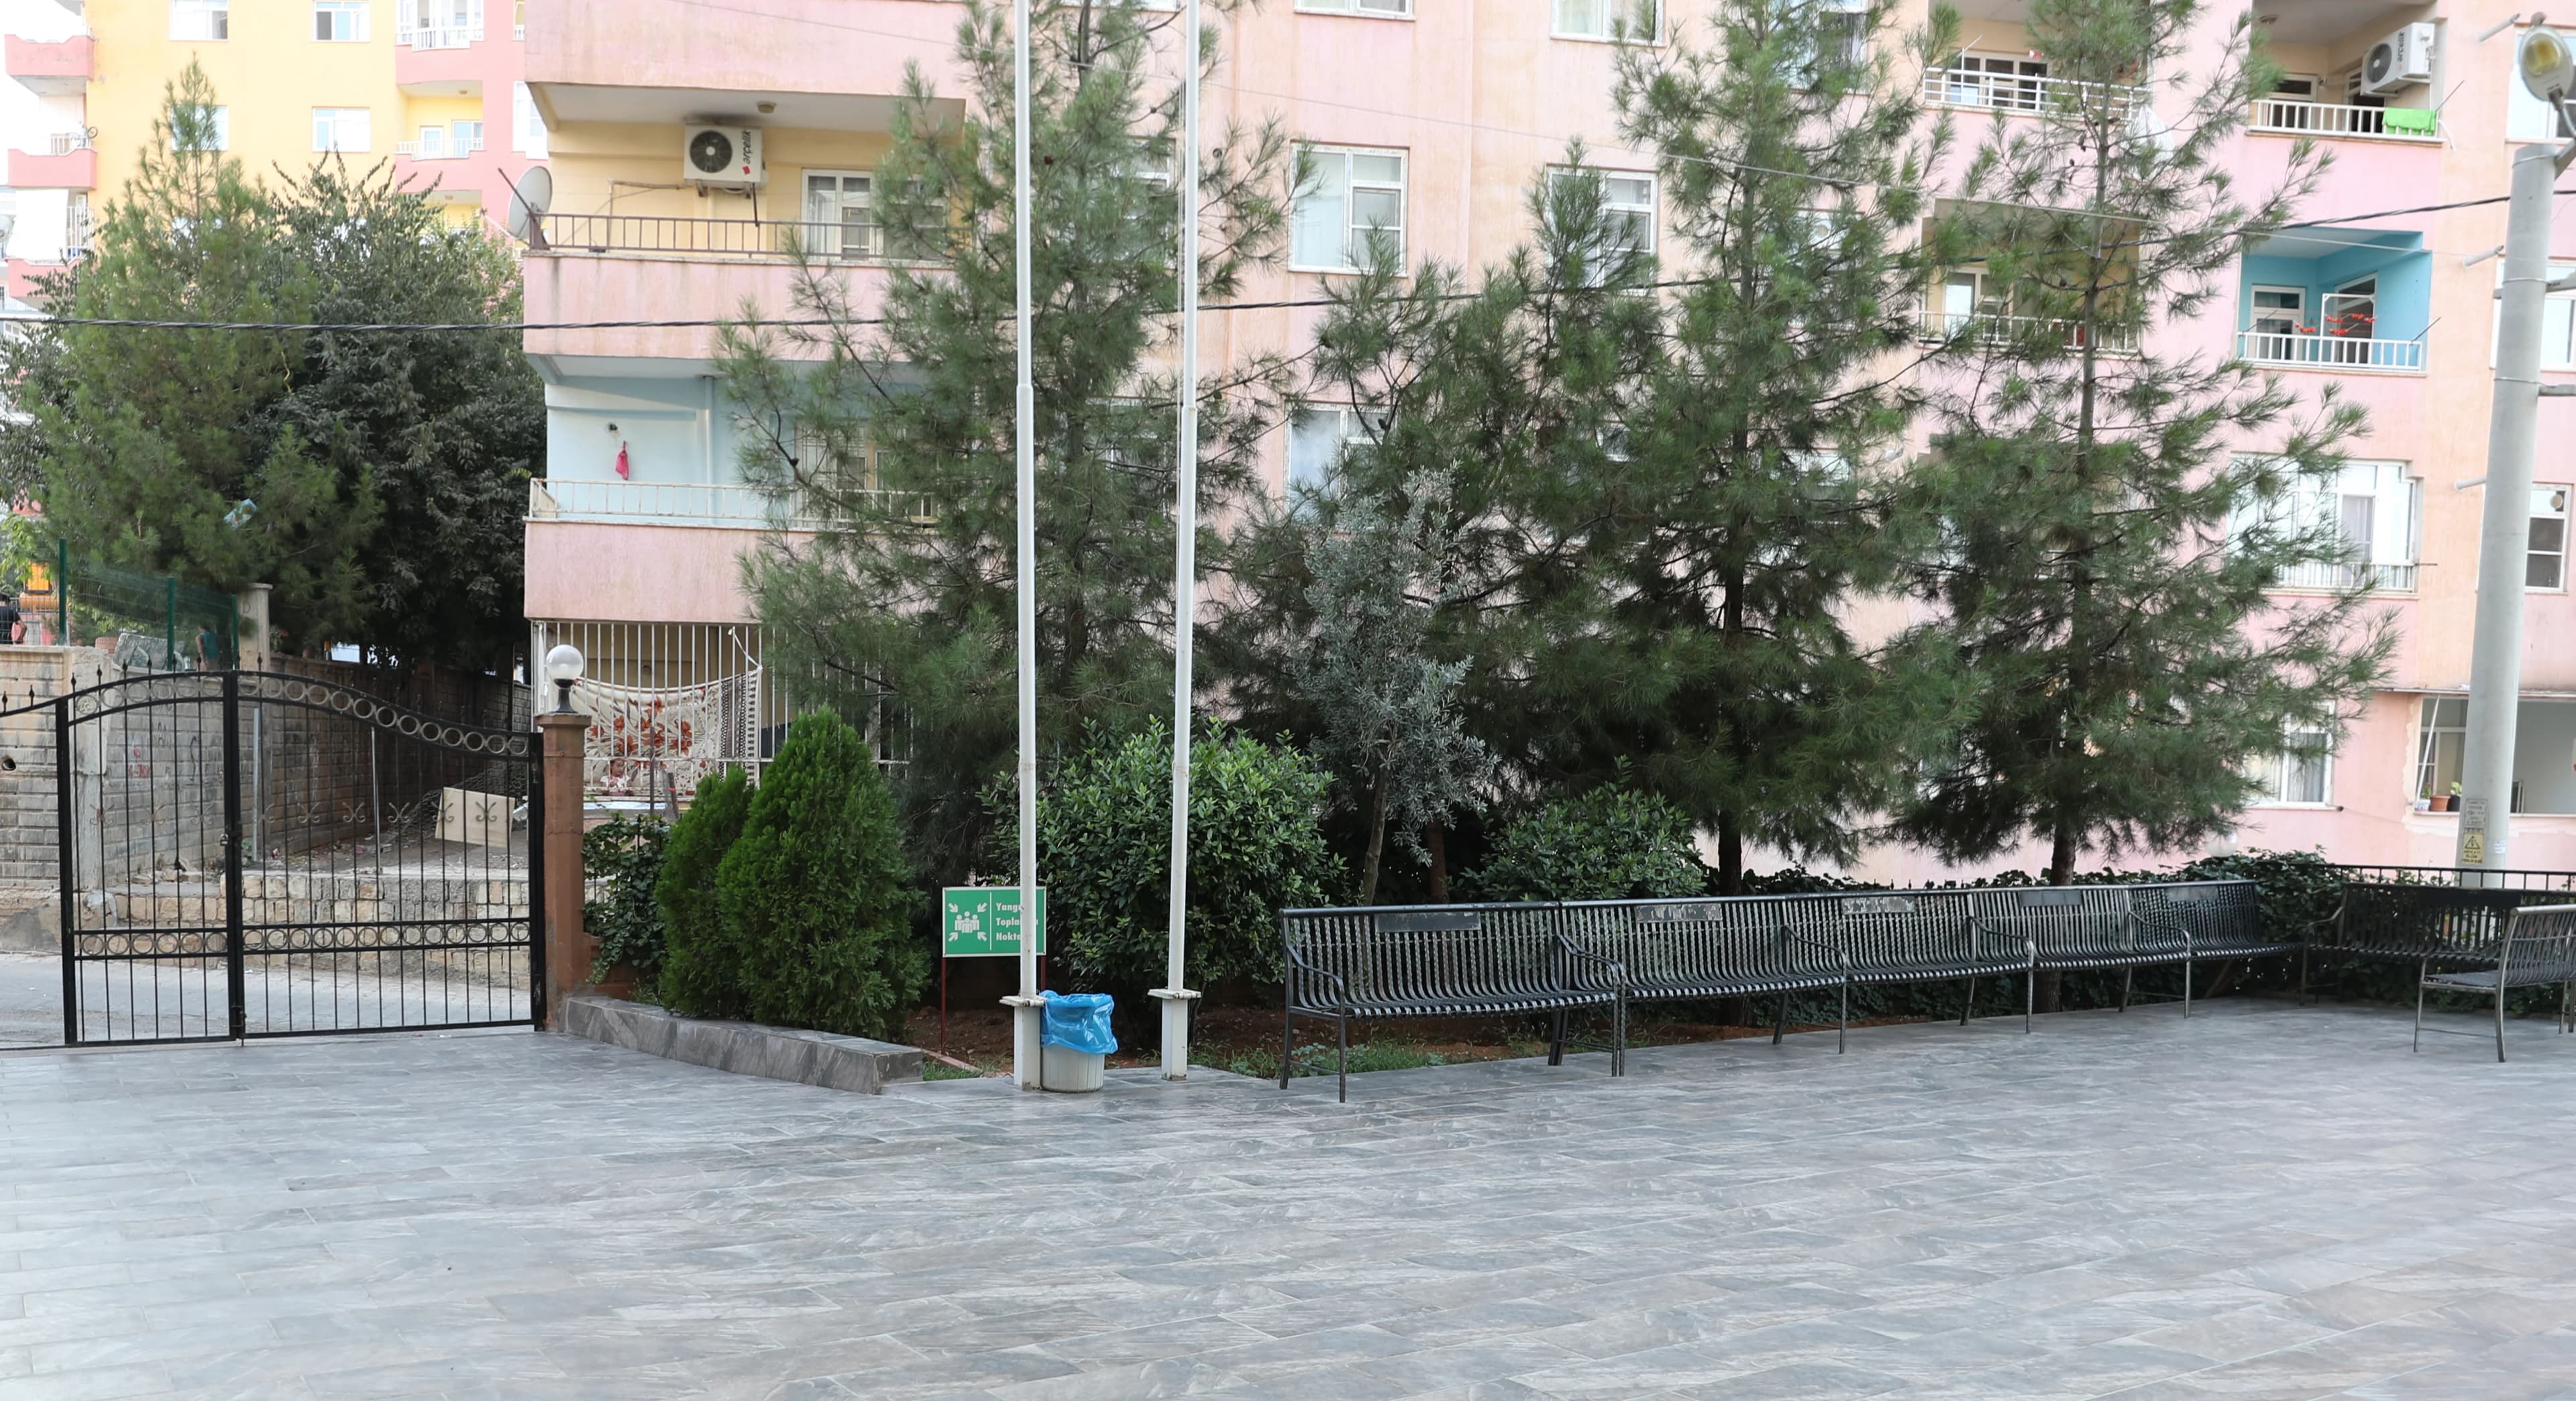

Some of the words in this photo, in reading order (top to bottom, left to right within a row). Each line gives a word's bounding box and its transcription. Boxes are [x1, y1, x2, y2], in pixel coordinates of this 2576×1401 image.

[741, 129, 753, 165] arçelik
[996, 902, 1021, 913] Yangı
[996, 917, 1038, 928] Topla
[996, 932, 1021, 941] Nokta
